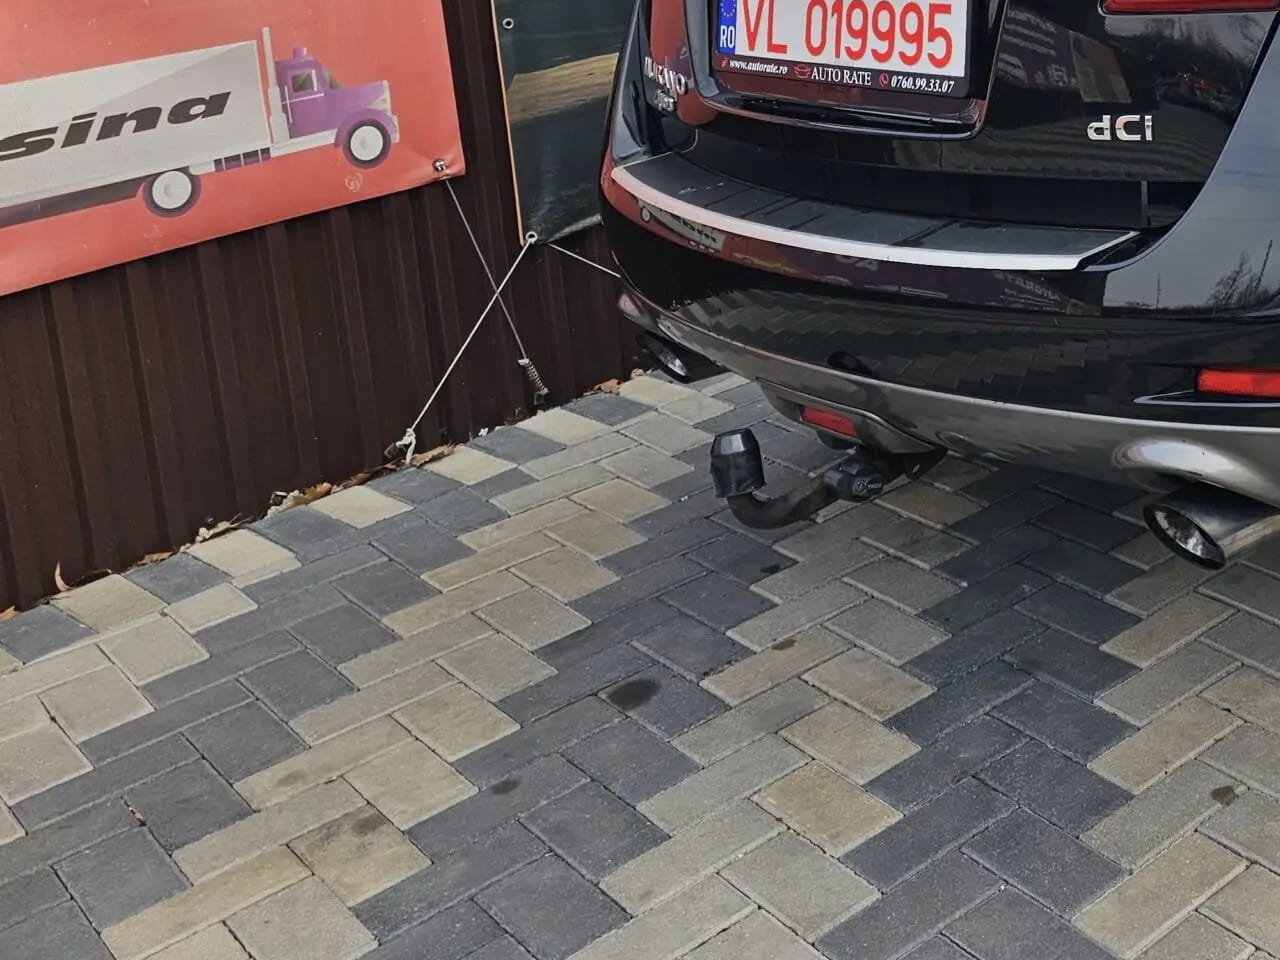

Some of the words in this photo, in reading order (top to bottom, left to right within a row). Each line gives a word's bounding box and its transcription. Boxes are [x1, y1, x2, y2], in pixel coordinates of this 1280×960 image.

[720, 25, 735, 49] RO
[729, 61, 788, 75] www.autorate.ro
[811, 68, 842, 83] AUTO
[844, 71, 872, 86] RATE
[891, 75, 955, 93] 0760.99.33.07
